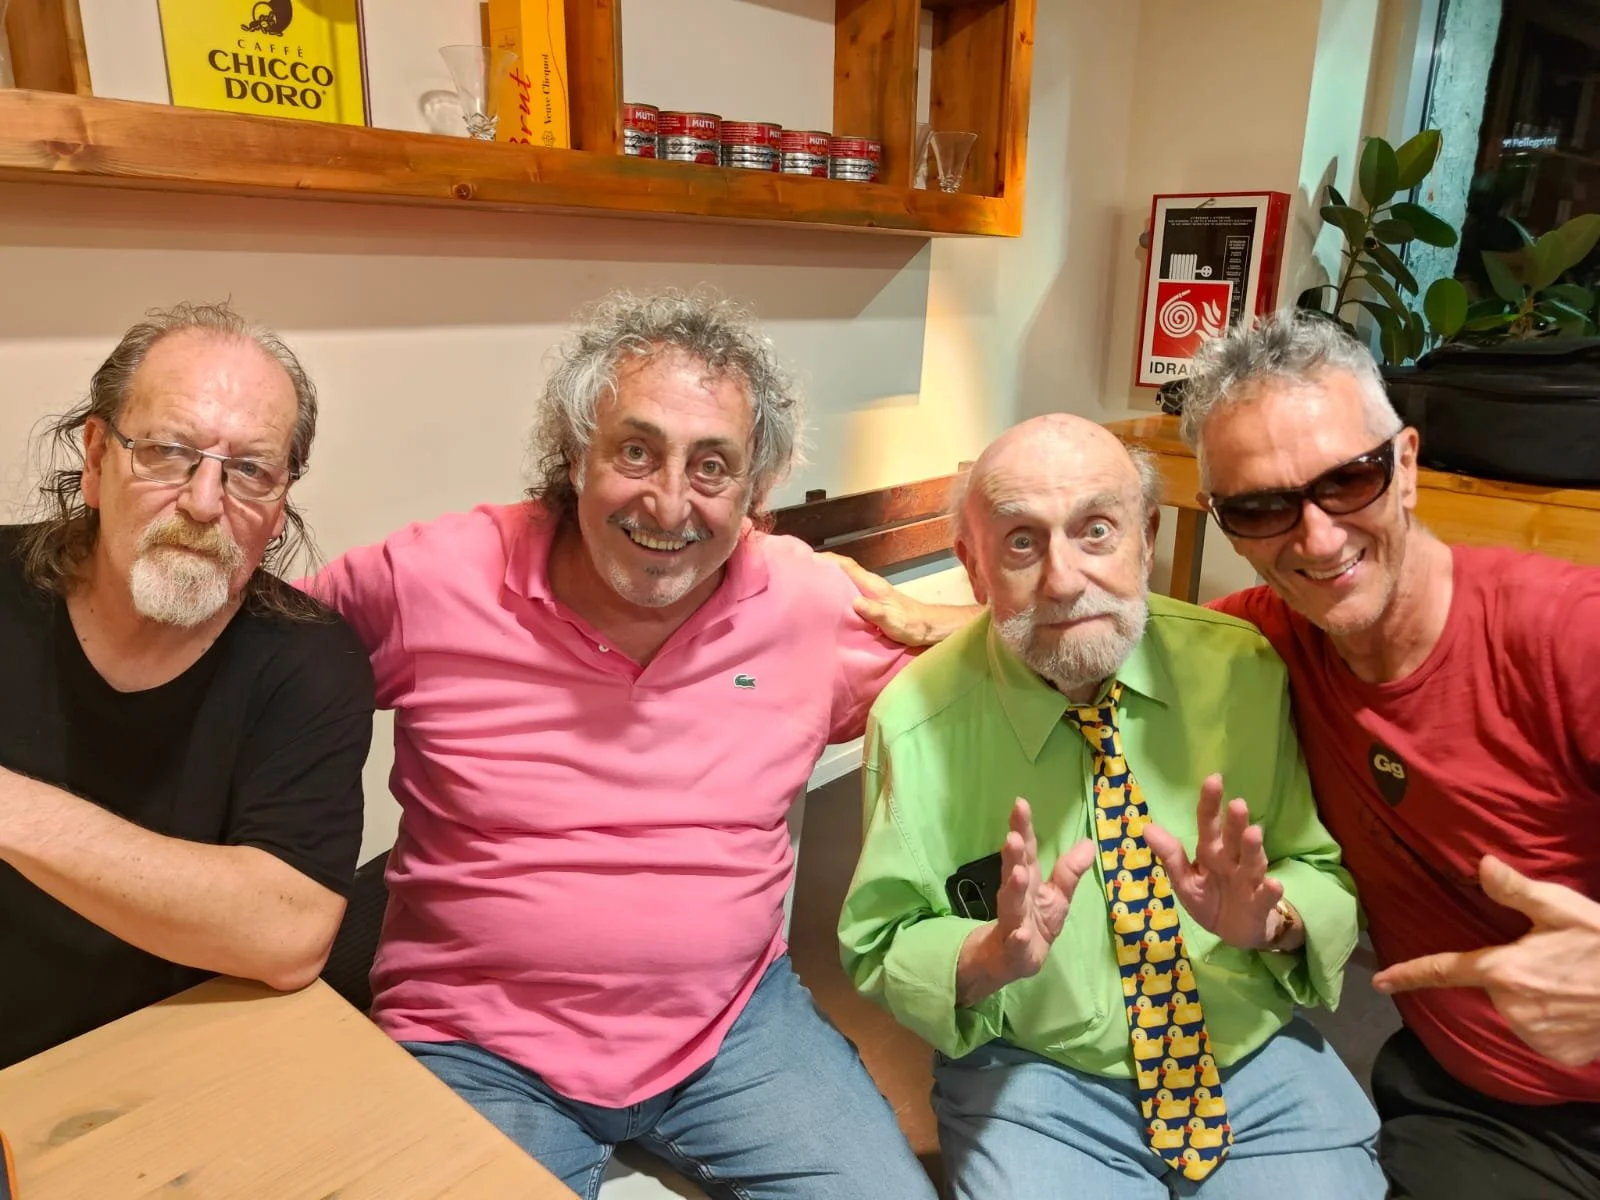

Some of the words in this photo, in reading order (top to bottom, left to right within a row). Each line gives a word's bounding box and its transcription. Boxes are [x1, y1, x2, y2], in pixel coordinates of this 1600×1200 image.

[237, 39, 303, 57] CAFFÈ
[208, 49, 334, 87] CHICCO
[541, 54, 551, 94] Clicquot
[543, 97, 552, 125] Veuve
[635, 111, 656, 121] MUTTI
[692, 119, 715, 129] MUTTI
[769, 129, 782, 139] MUT
[809, 136, 828, 145] MUTTI
[868, 143, 881, 152] MUTT
[1149, 361, 1200, 376] IDRAN
